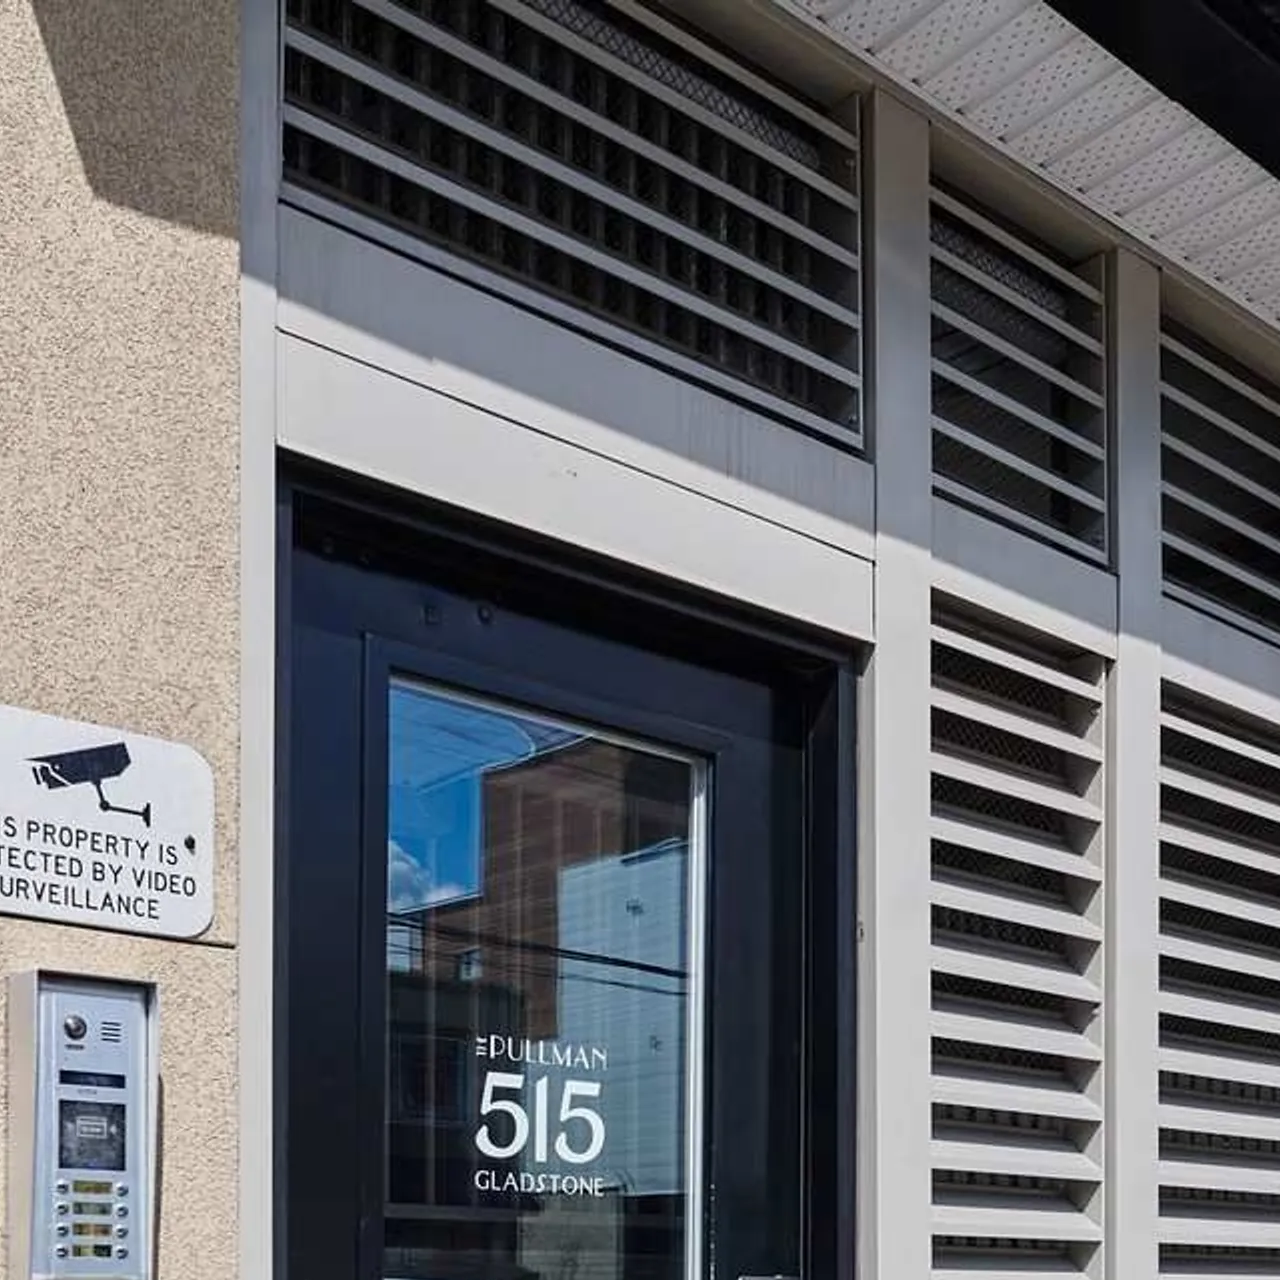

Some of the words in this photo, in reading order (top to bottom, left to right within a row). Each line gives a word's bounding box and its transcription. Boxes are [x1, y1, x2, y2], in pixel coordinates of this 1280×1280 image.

[26, 820, 149, 860] PROPERTY
[158, 844, 178, 866] IS
[91, 861, 123, 885] BY
[132, 867, 197, 897] VIDEO
[489, 1034, 607, 1070] PULLMAN
[475, 1071, 606, 1164] 515
[474, 1169, 605, 1198] GLADSTONE
